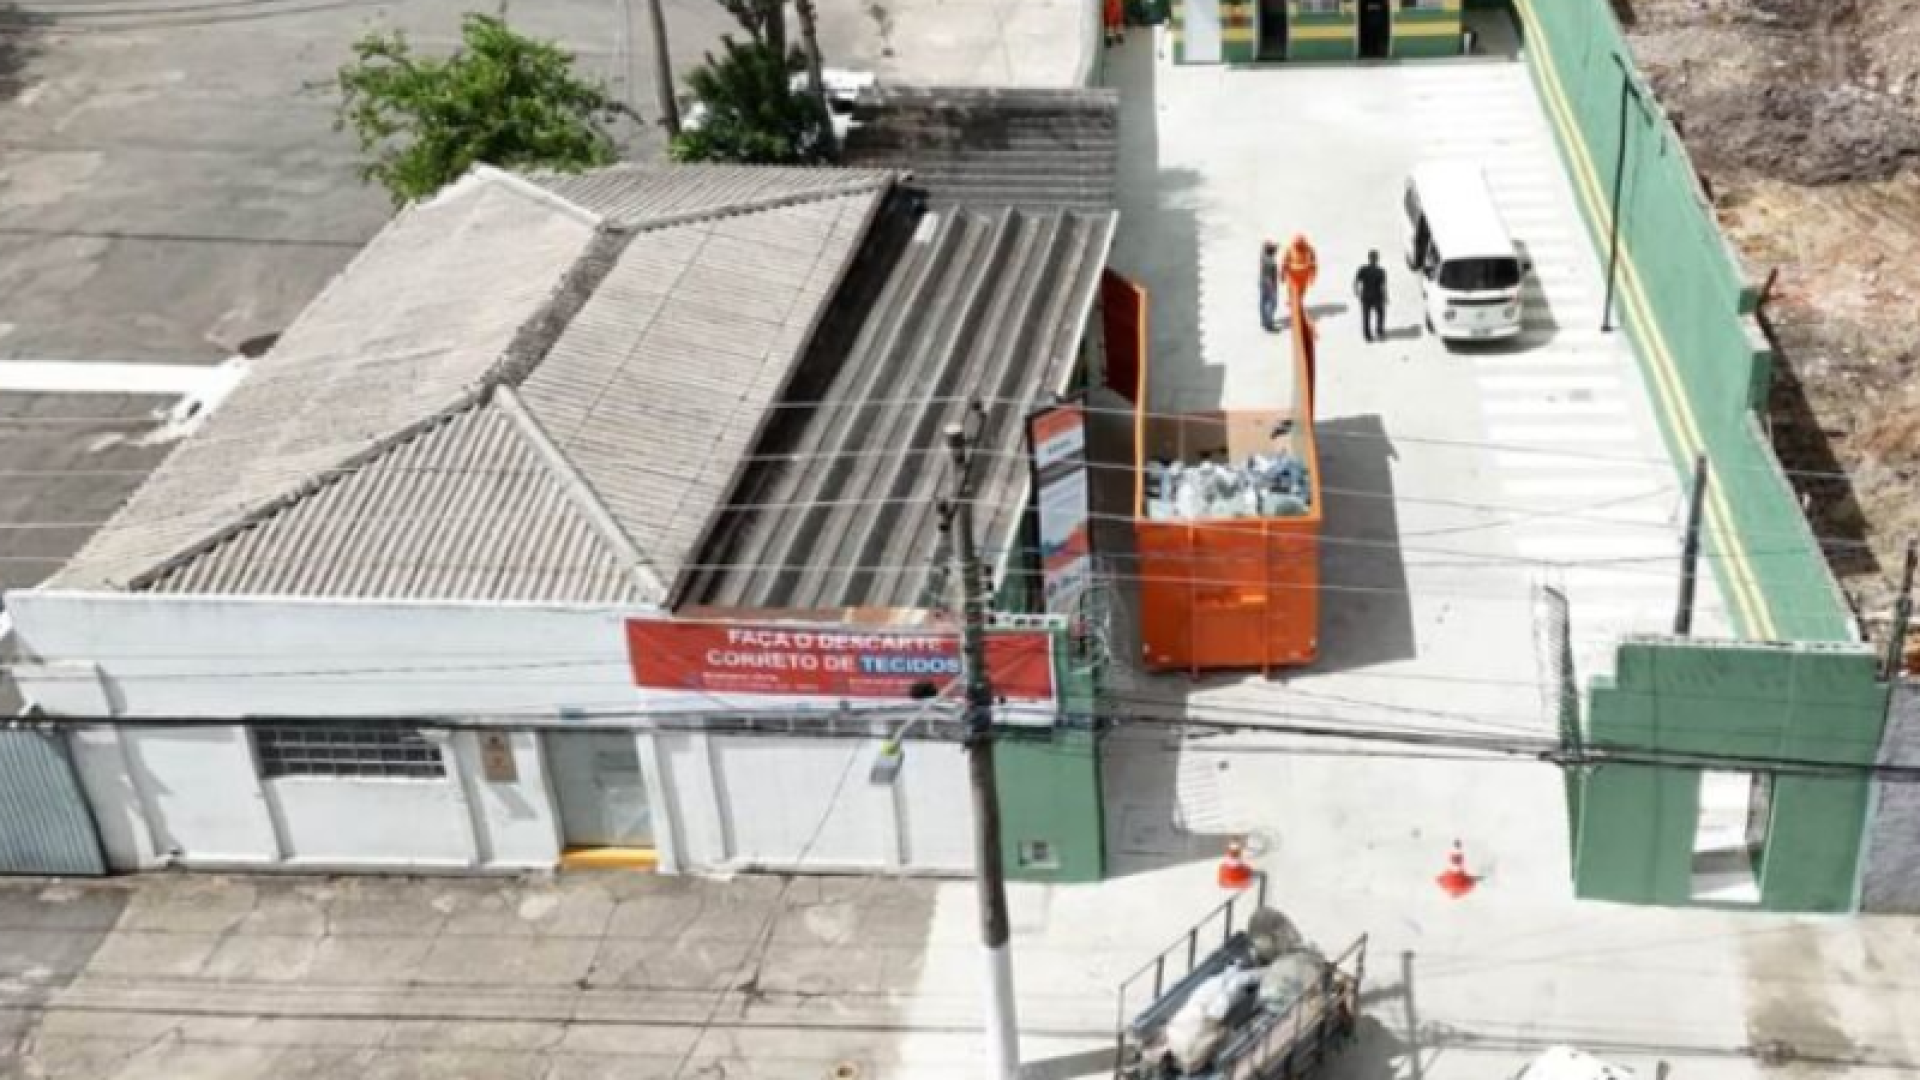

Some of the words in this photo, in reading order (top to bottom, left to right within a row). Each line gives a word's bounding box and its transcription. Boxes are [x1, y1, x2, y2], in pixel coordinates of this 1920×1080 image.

[727, 629, 791, 650] FAÇA
[793, 633, 812, 650] O
[817, 633, 941, 652] DESCARTE
[706, 648, 818, 671] CORRETO
[823, 653, 855, 672] DE
[861, 655, 960, 673] TECIDOS
